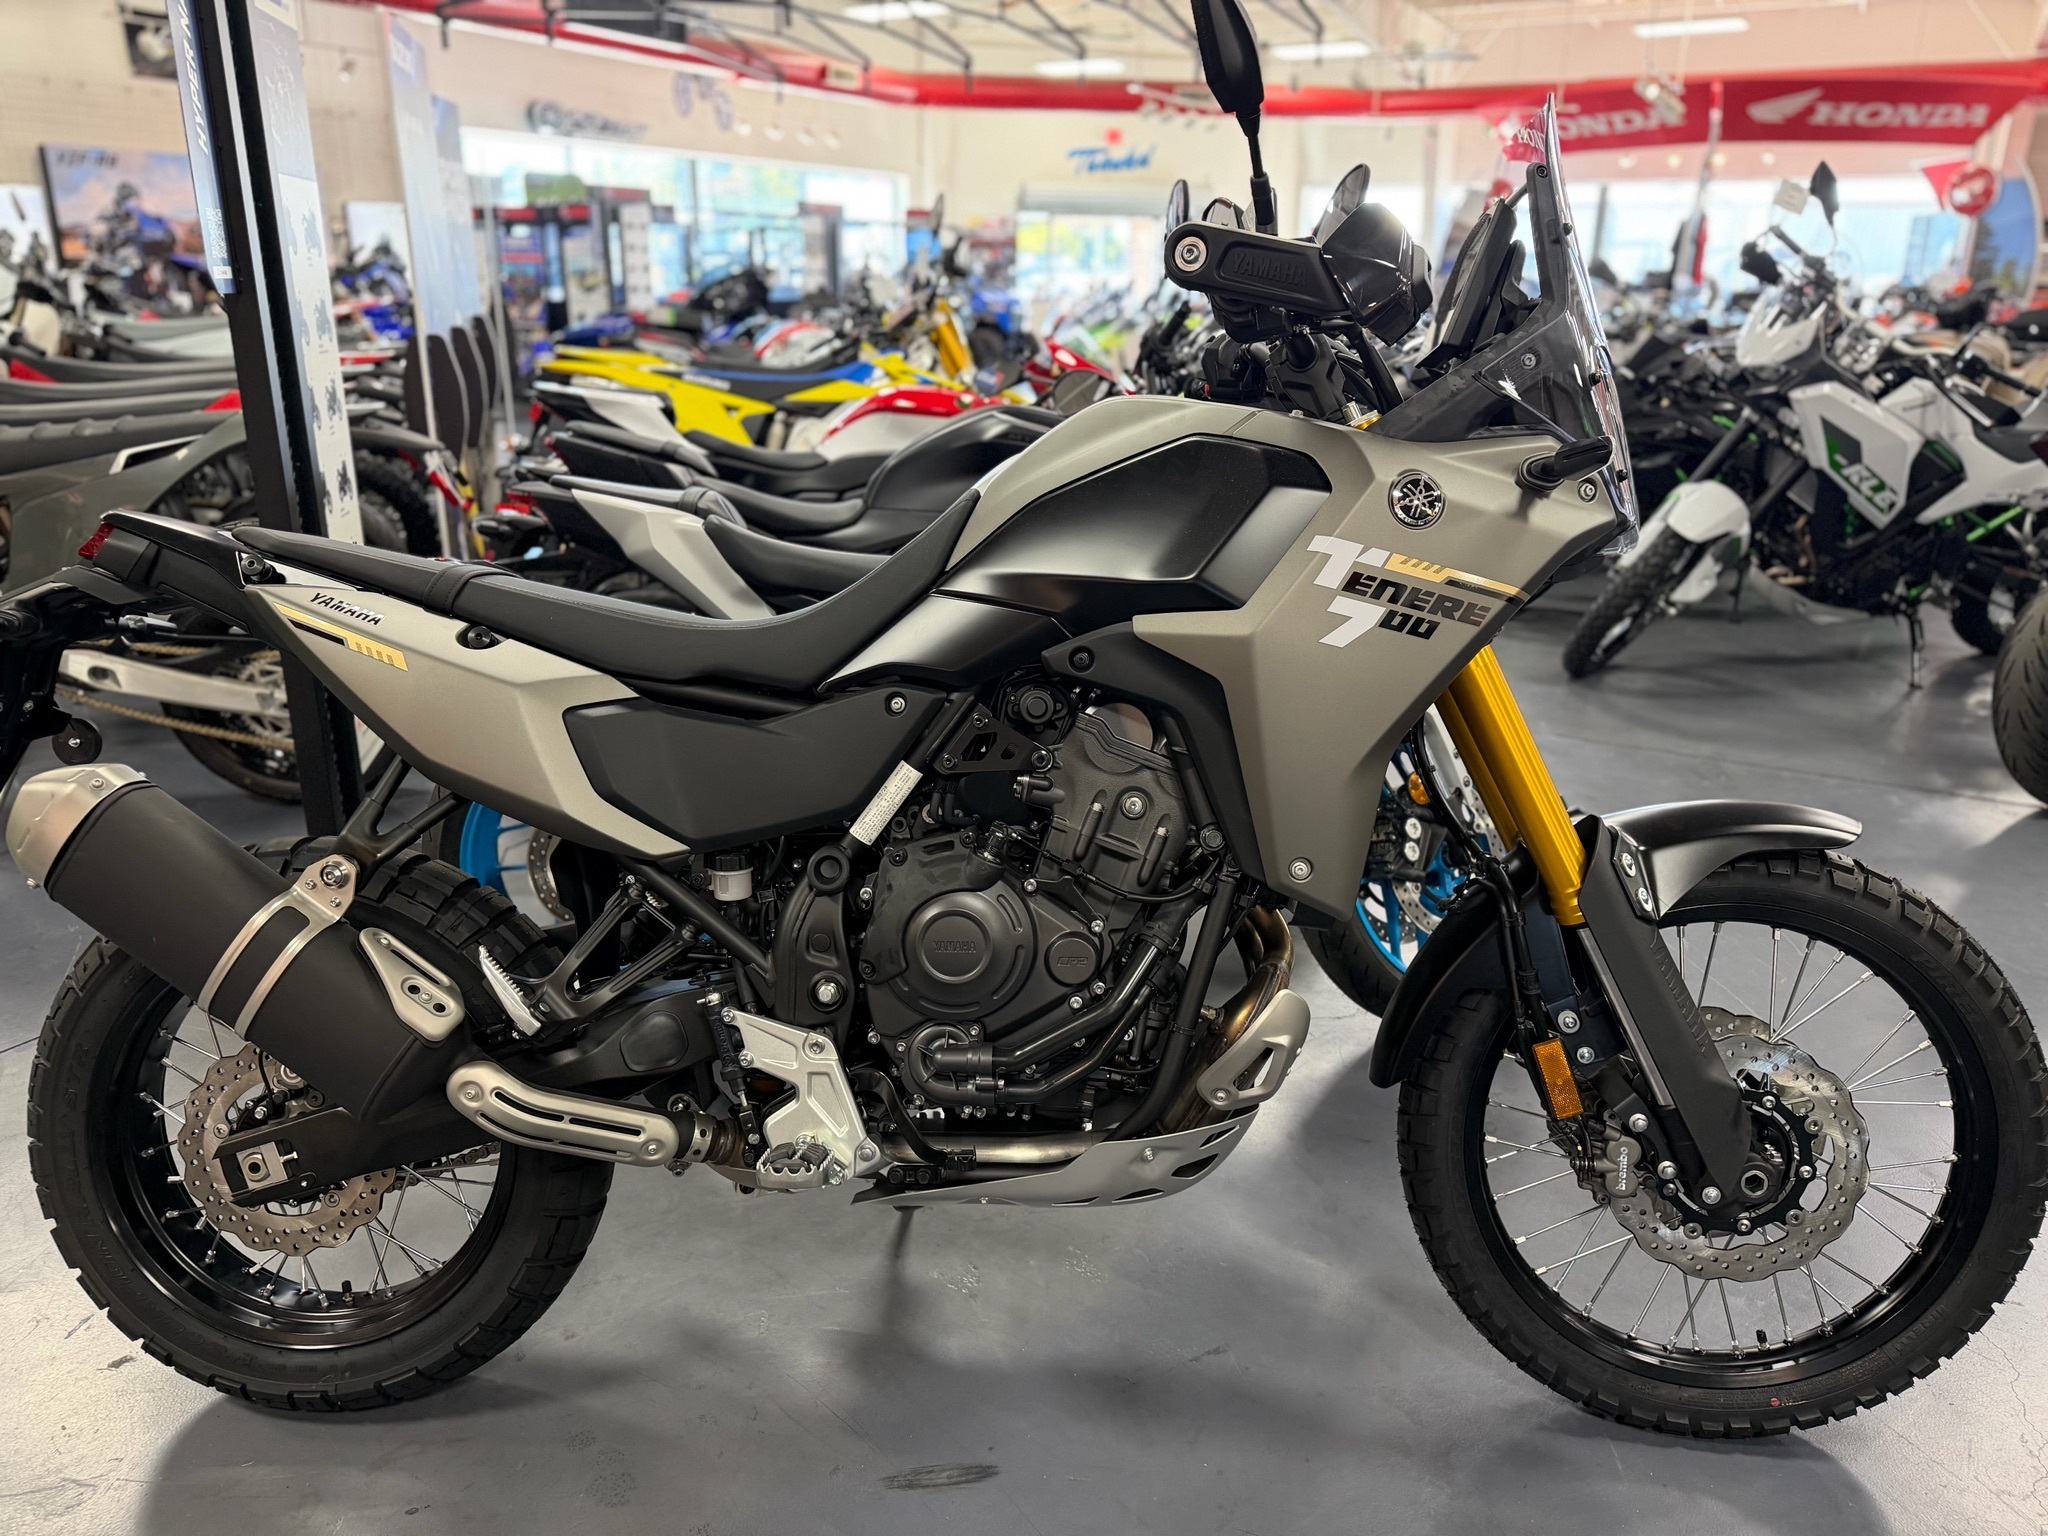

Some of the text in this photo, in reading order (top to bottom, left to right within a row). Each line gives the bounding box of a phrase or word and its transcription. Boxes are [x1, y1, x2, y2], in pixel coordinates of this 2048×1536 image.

[183, 39, 209, 155] HYPER
[1807, 101, 1990, 128] HONDA
[1231, 250, 1308, 287] YAMAHA
[310, 592, 385, 626] YAMAHA
[1318, 595, 1441, 648] 700
[932, 940, 977, 953] YAMAHA
[1615, 1146, 1628, 1190] brembo
